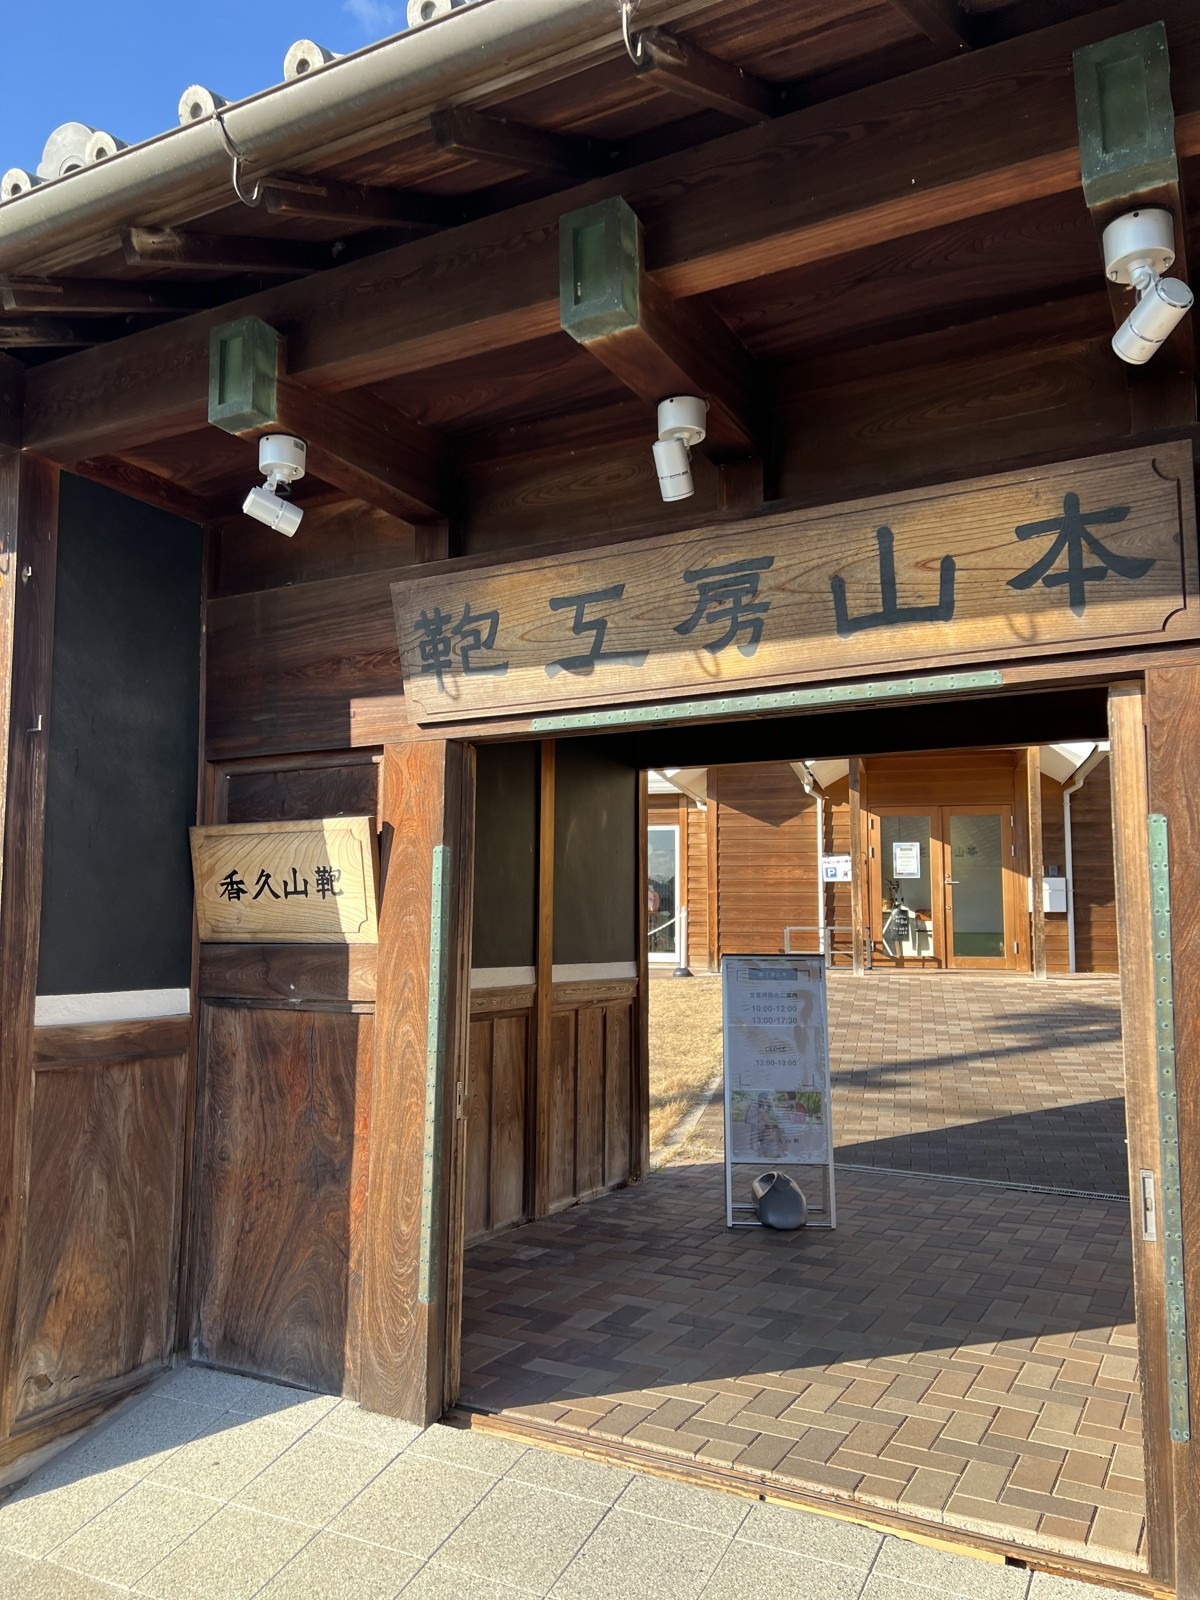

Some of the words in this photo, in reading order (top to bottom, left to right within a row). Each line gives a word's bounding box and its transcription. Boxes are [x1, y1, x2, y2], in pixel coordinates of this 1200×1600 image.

[413, 491, 1156, 694] 鞄工房山本
[219, 865, 344, 902] 香久山鞄
